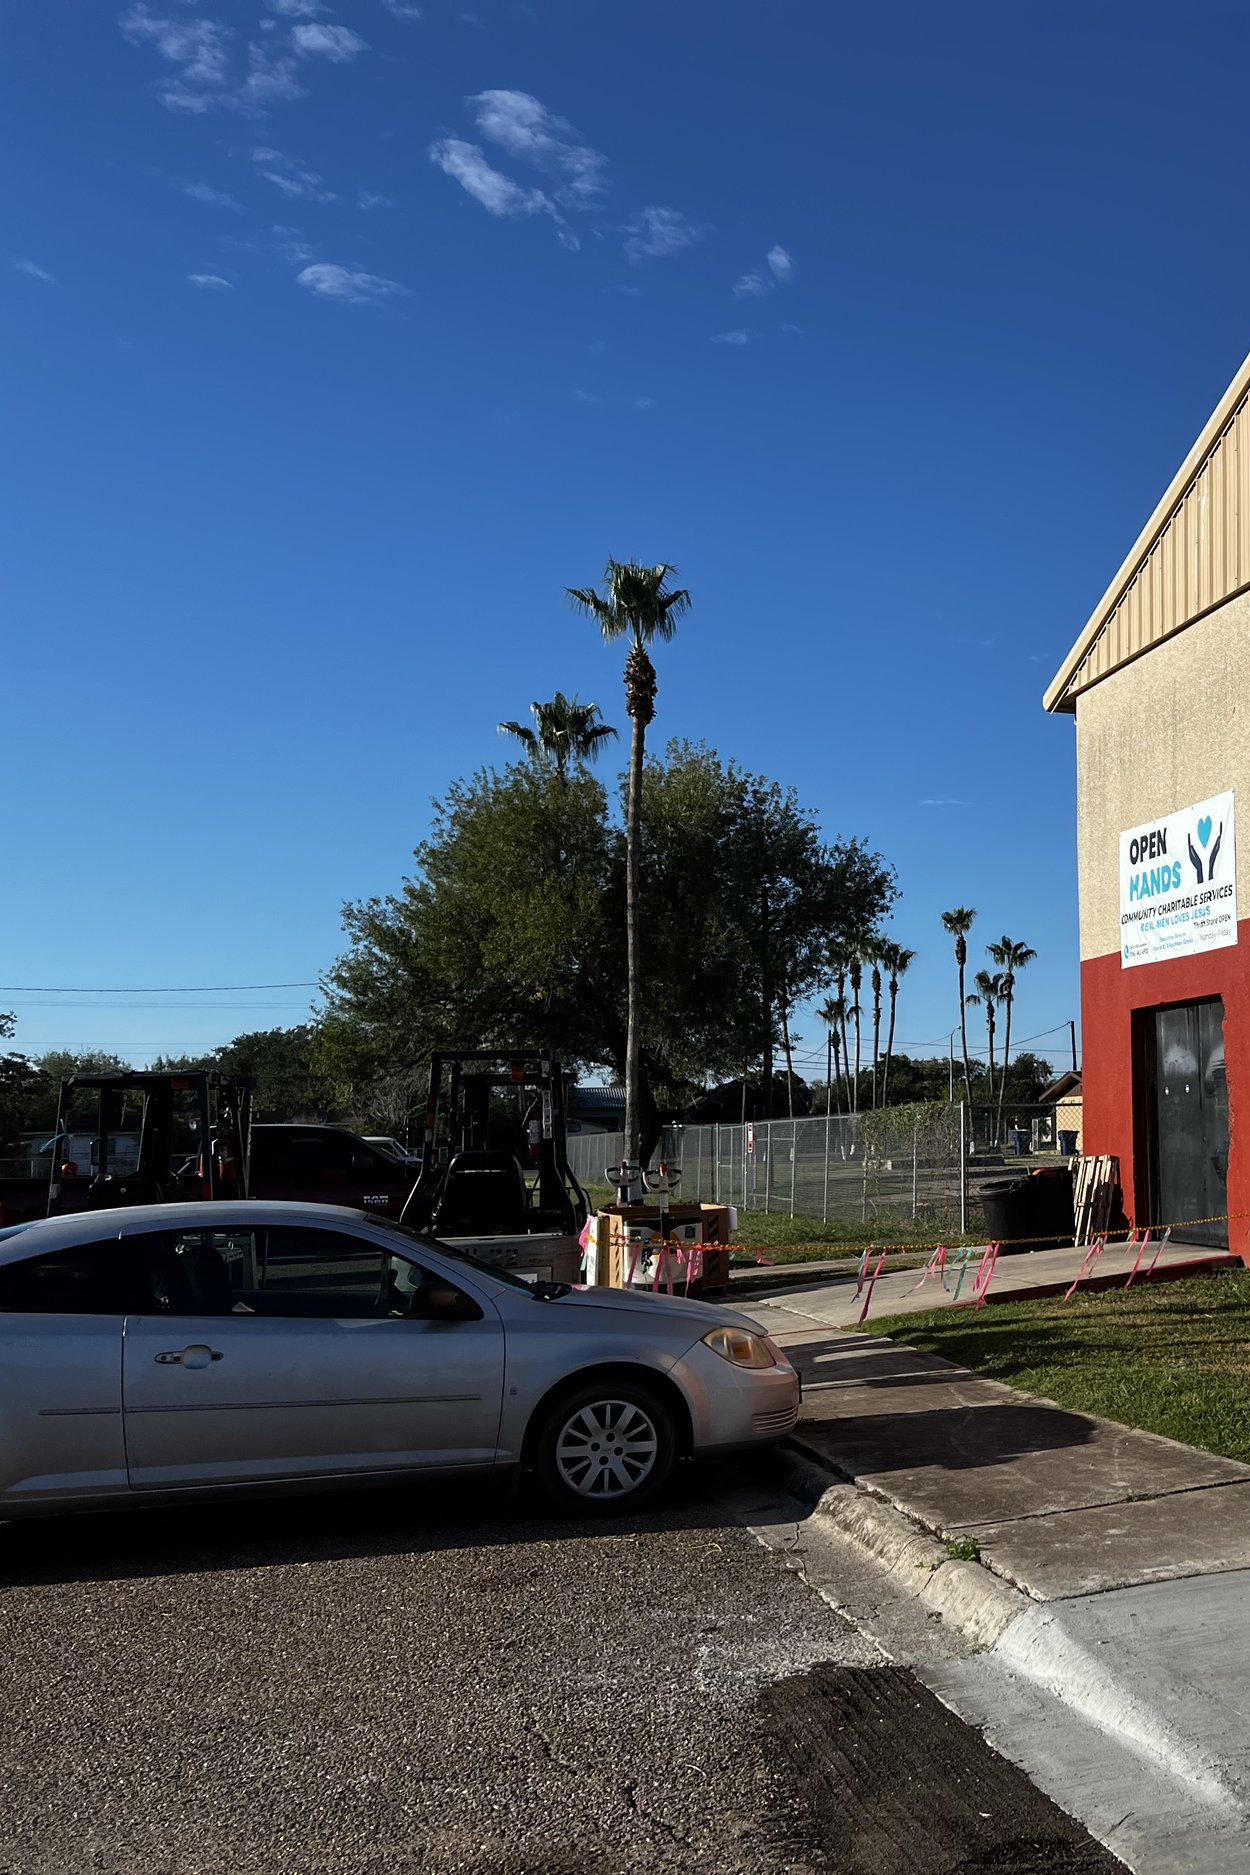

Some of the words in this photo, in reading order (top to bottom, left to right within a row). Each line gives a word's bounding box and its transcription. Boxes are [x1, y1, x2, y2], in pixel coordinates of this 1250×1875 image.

[1129, 828, 1167, 865] OPEN
[1129, 861, 1182, 902] HANDS
[1121, 907, 1157, 925] COMMUNITY
[1158, 894, 1198, 916] CHARITABLE
[1199, 884, 1233, 905] SERVICES
[1156, 918, 1170, 929] MEN
[1171, 912, 1190, 925] LOVES
[1191, 905, 1211, 919] JESUS
[1218, 914, 1232, 924] OPEN
